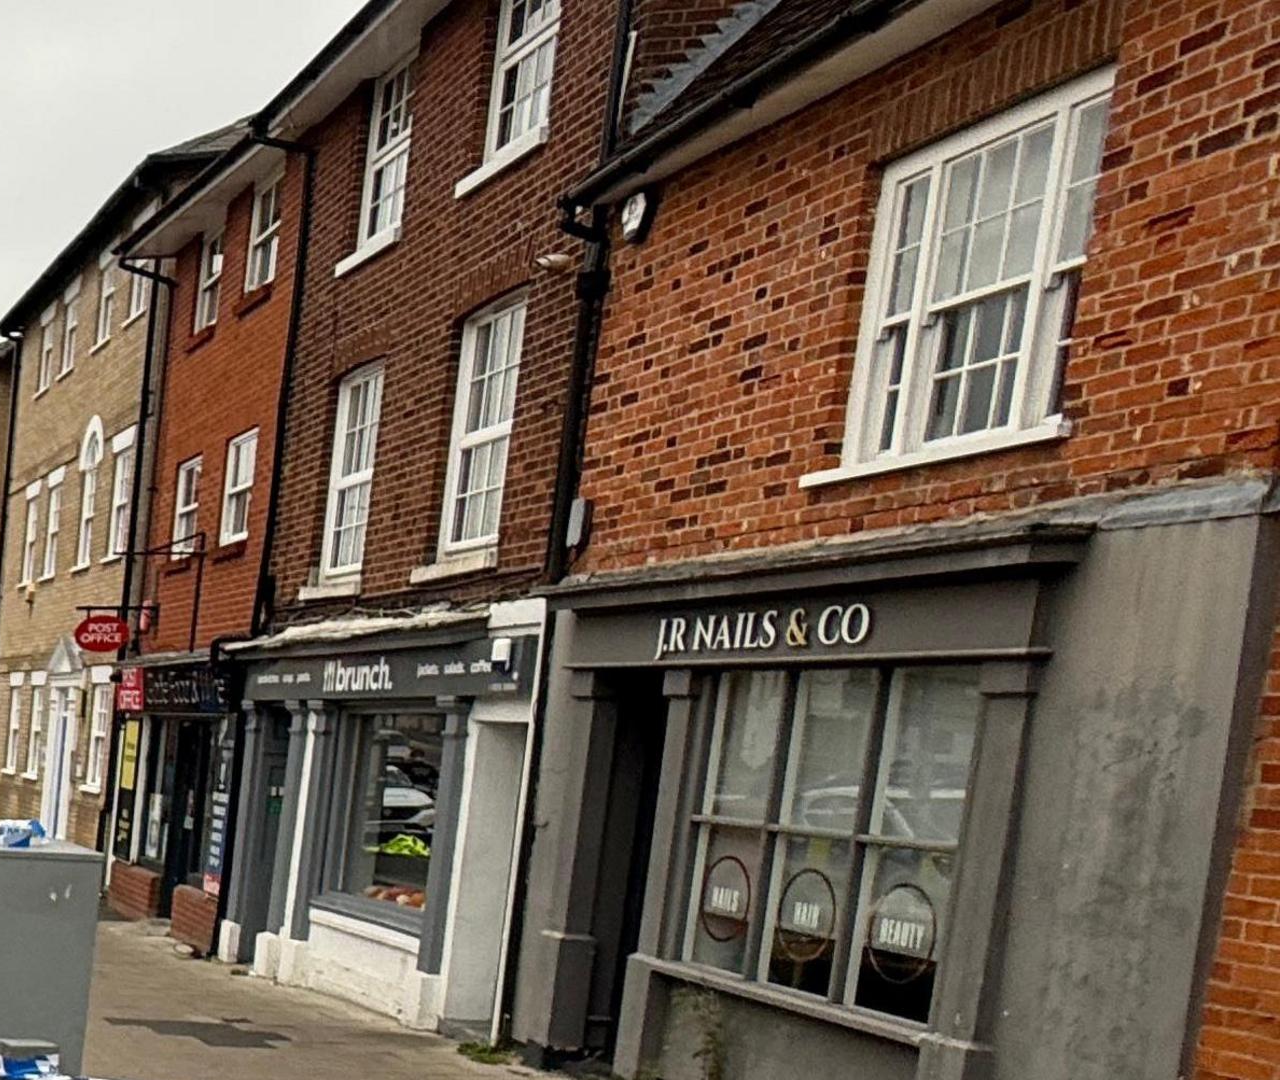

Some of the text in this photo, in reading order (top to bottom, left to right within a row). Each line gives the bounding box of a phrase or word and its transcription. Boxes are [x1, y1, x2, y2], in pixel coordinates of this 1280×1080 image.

[79, 632, 122, 644] OFFICE
[88, 622, 120, 632] POST
[692, 609, 778, 651] NAILS
[785, 607, 808, 647] &
[817, 602, 871, 645] CO
[711, 886, 740, 914] NAILS
[793, 901, 821, 929] HAIR
[878, 917, 926, 950] BEAUTY
